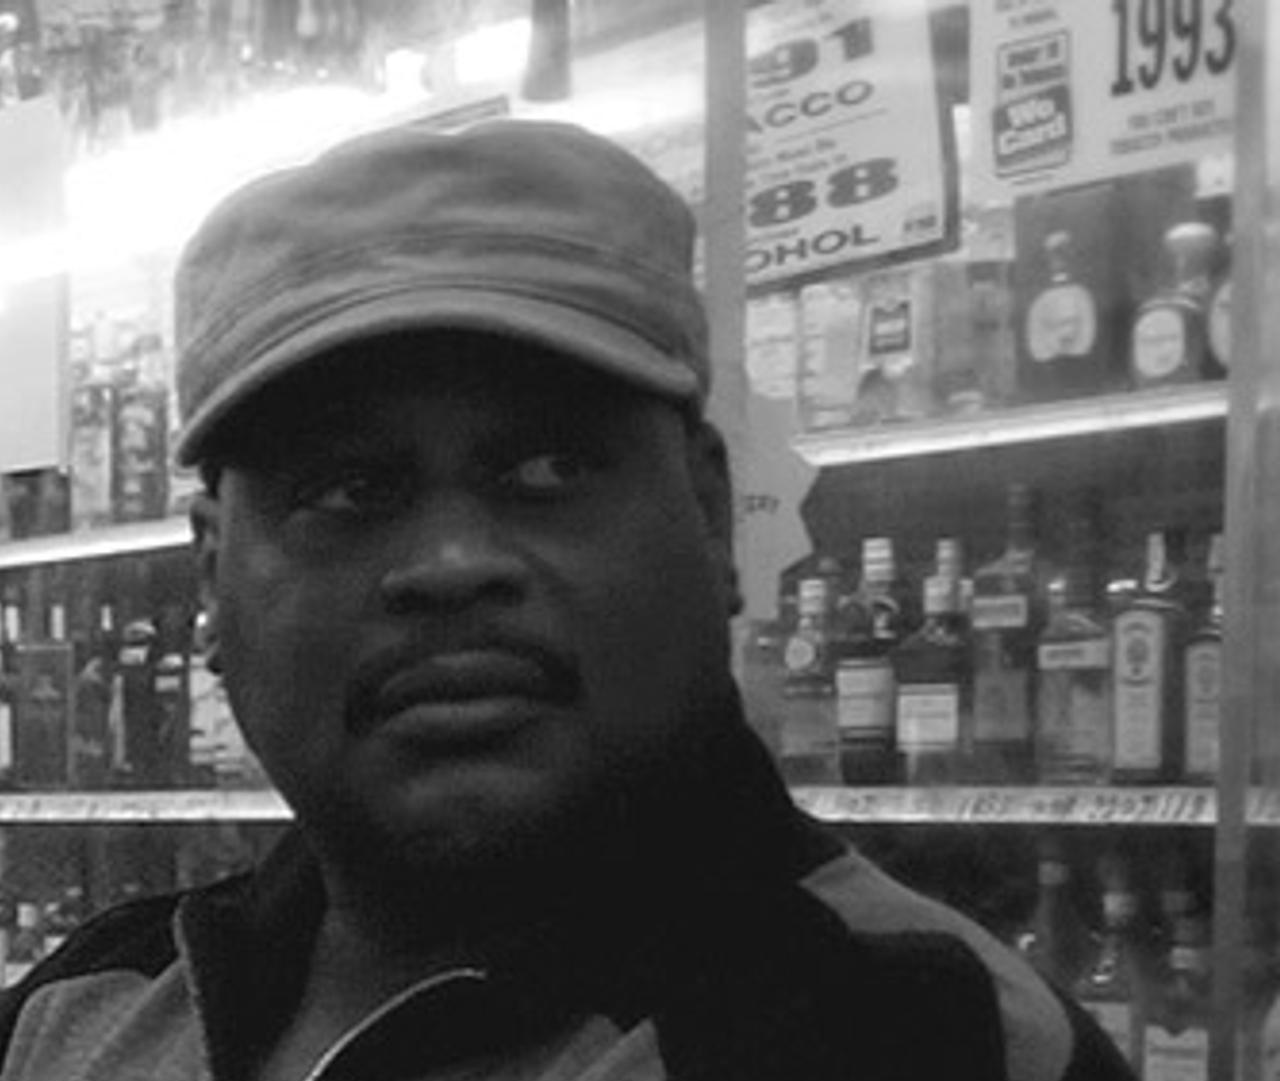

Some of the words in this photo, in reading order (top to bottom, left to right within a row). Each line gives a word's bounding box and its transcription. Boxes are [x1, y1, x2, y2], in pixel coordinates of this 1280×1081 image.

[748, 16, 874, 89] 91
[1110, 0, 1237, 97] 1993
[749, 156, 900, 229] 88
